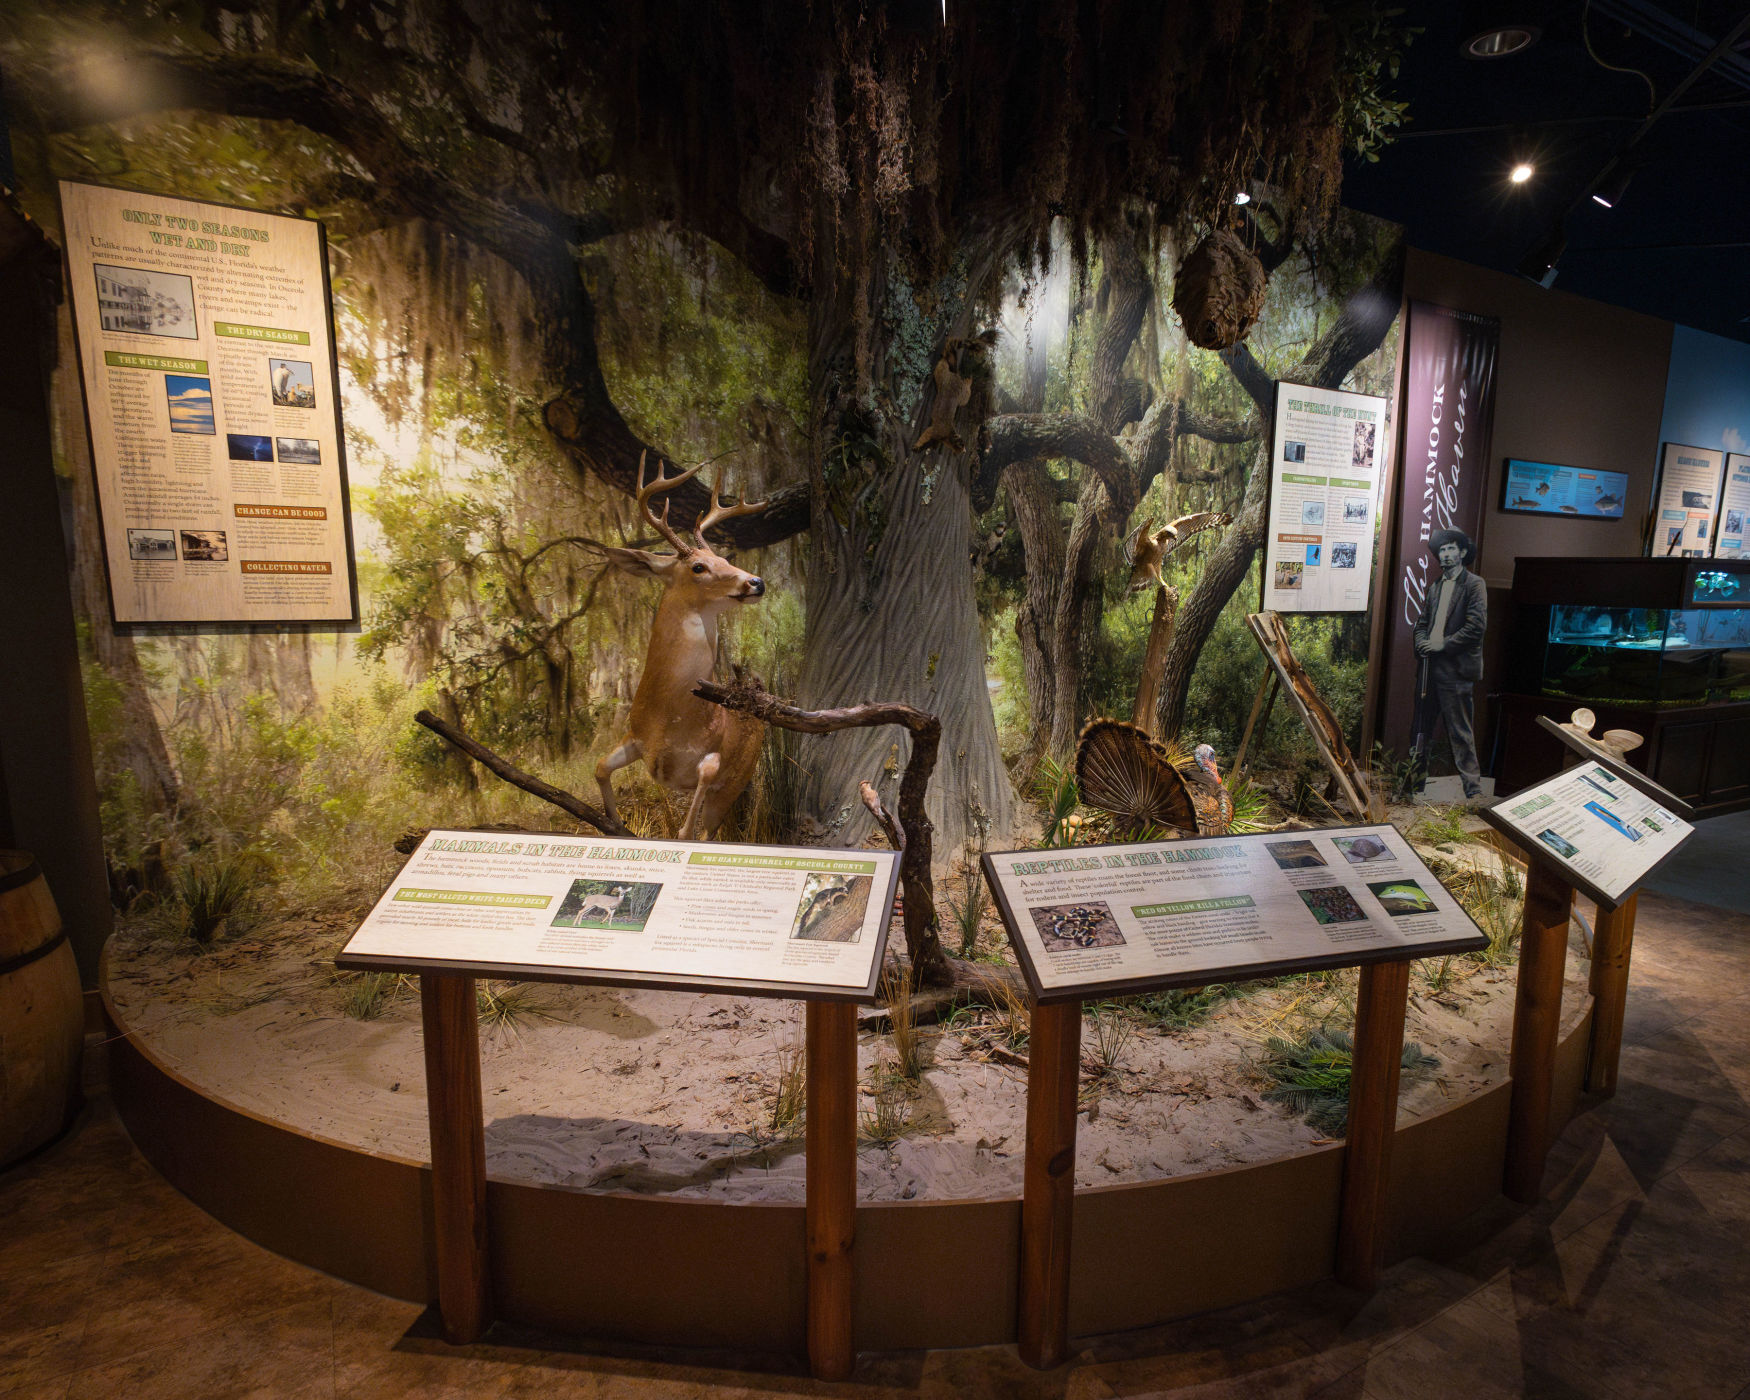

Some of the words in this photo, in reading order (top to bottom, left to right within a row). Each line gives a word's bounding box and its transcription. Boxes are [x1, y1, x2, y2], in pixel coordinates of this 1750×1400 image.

[122, 209, 162, 225] ONLY
[165, 215, 198, 231] TWO
[201, 222, 269, 241] SEASONS
[90, 236, 119, 249] Unlike
[168, 252, 209, 261] continental
[149, 231, 183, 247] WET
[184, 236, 217, 252] AND
[220, 242, 251, 256] DRY
[91, 251, 122, 260] patterns
[138, 256, 163, 266] usually
[166, 261, 214, 271] characterized
[226, 270, 263, 279] alternating
[197, 284, 223, 294] County
[278, 285, 304, 293] Osceola
[199, 303, 224, 311] change
[234, 298, 261, 307] swamps
[227, 326, 244, 334] THE
[246, 328, 263, 336] DRY
[265, 330, 298, 340] SEASON
[118, 356, 137, 364] THE
[139, 358, 157, 366] WET
[160, 360, 196, 369] SEASON
[1404, 554, 1429, 626] The
[1420, 384, 1445, 542] HAMMOCK
[1436, 379, 1468, 530] Haven
[428, 839, 523, 854] MAMMALS
[523, 843, 547, 856] IN
[547, 844, 586, 858] THE
[587, 846, 684, 862] HAMMOCK
[1011, 857, 1102, 875] REPTILES
[1102, 854, 1125, 868] IN
[1124, 851, 1161, 865] THE
[1160, 845, 1247, 862] HAMMOCK
